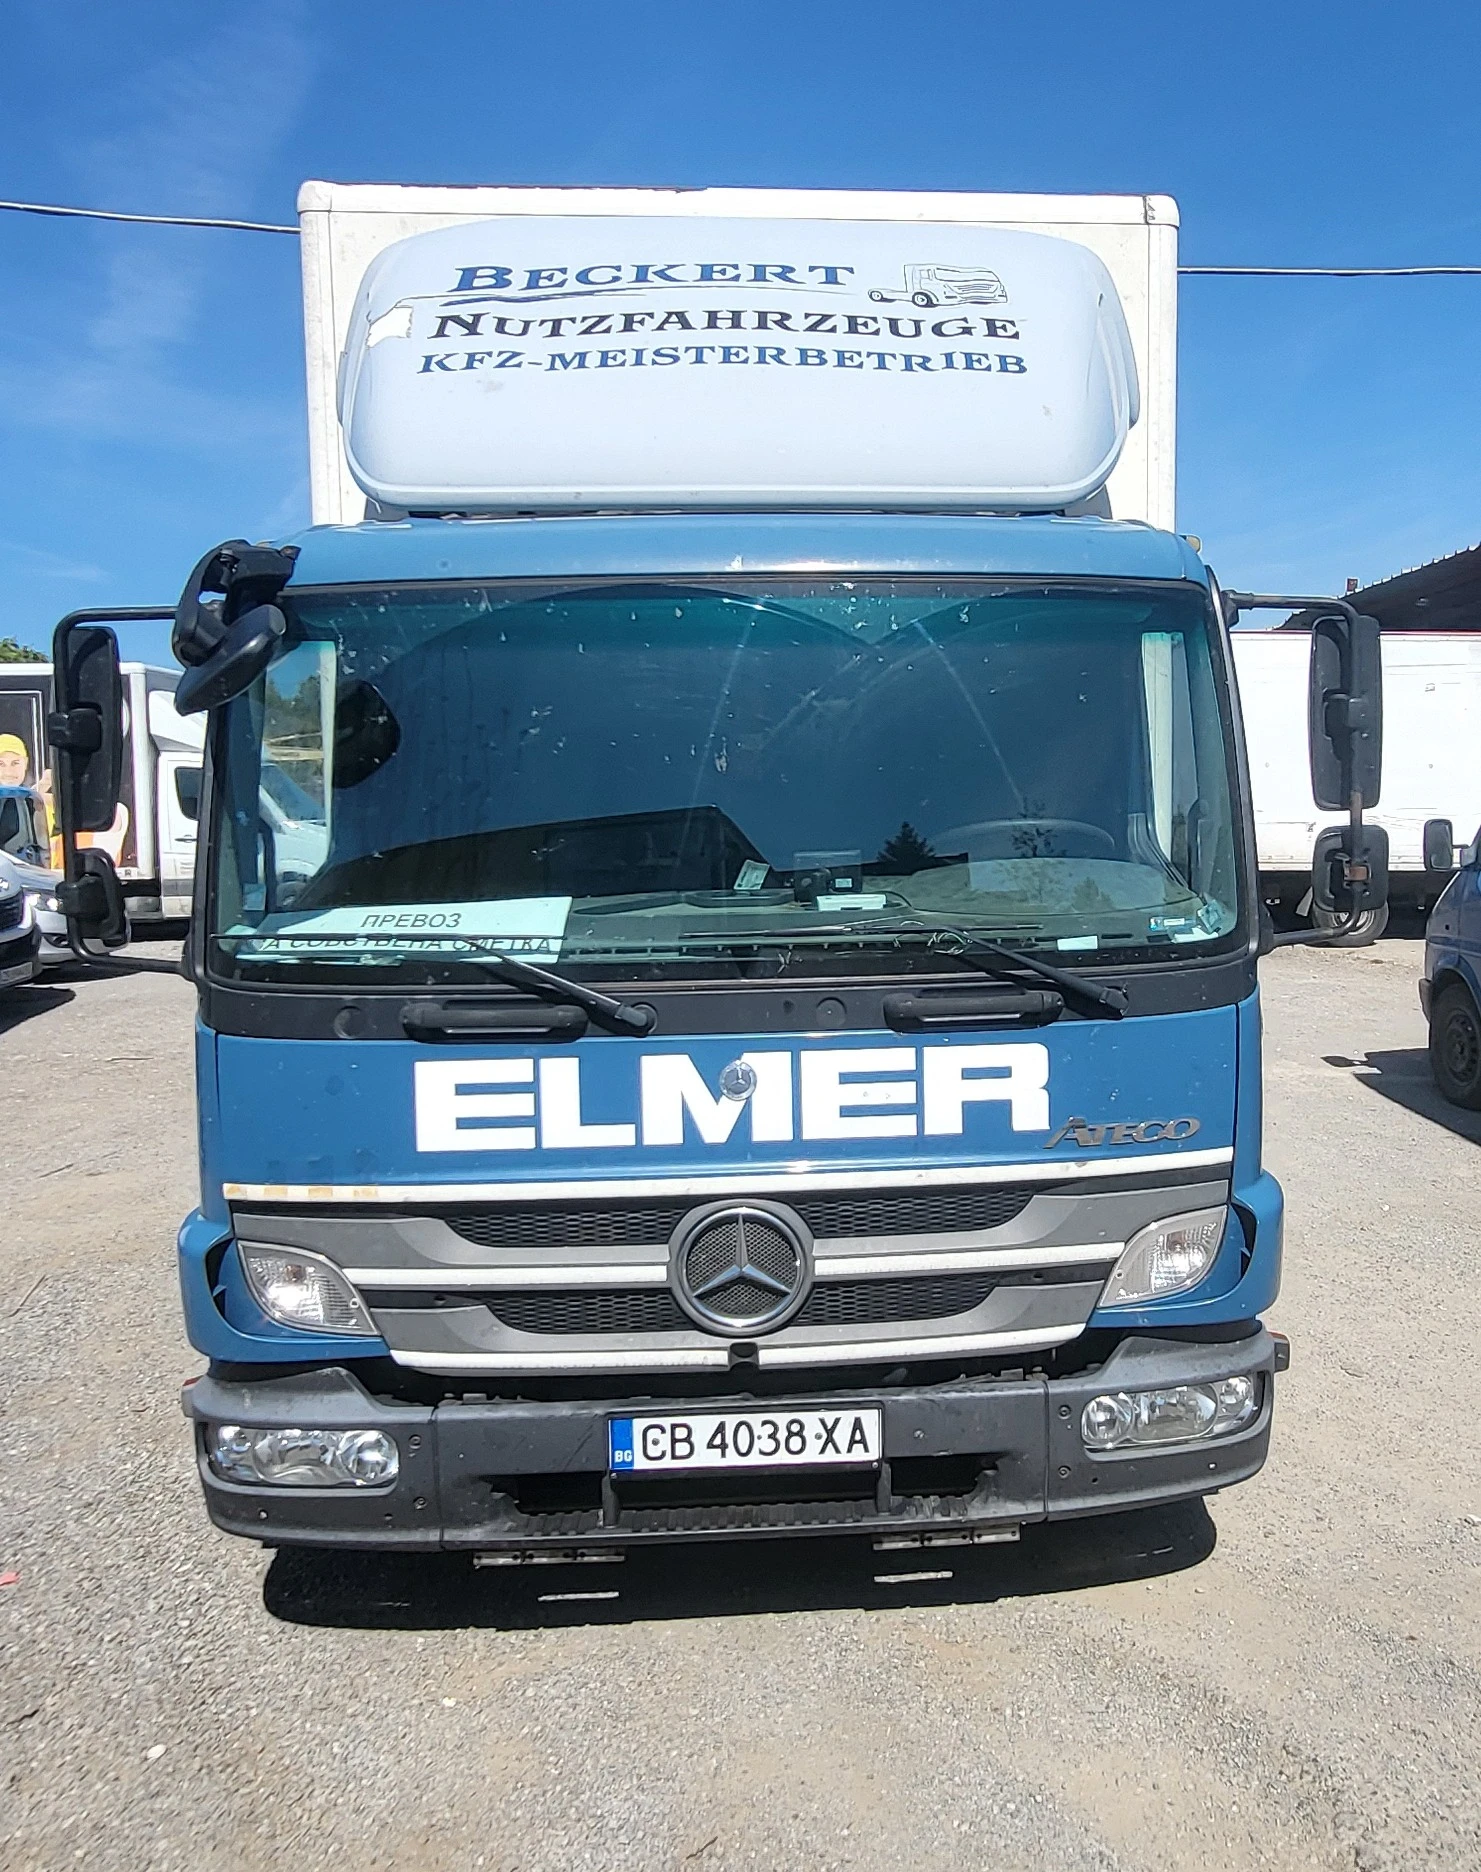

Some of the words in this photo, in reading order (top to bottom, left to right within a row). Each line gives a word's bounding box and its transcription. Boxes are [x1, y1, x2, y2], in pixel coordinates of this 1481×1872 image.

[446, 264, 855, 291] BECKERT
[427, 310, 1020, 340] NUTZFAHRZEUGE
[418, 346, 1028, 374] KFZ-MEISTERBETRIEB
[360, 912, 462, 930] ПРЕВОЗ
[413, 1043, 1050, 1152] ELMER
[642, 1422, 695, 1461] CB
[706, 1418, 806, 1459] 4038
[818, 1416, 870, 1455] XA
[613, 1450, 633, 1463] BG
